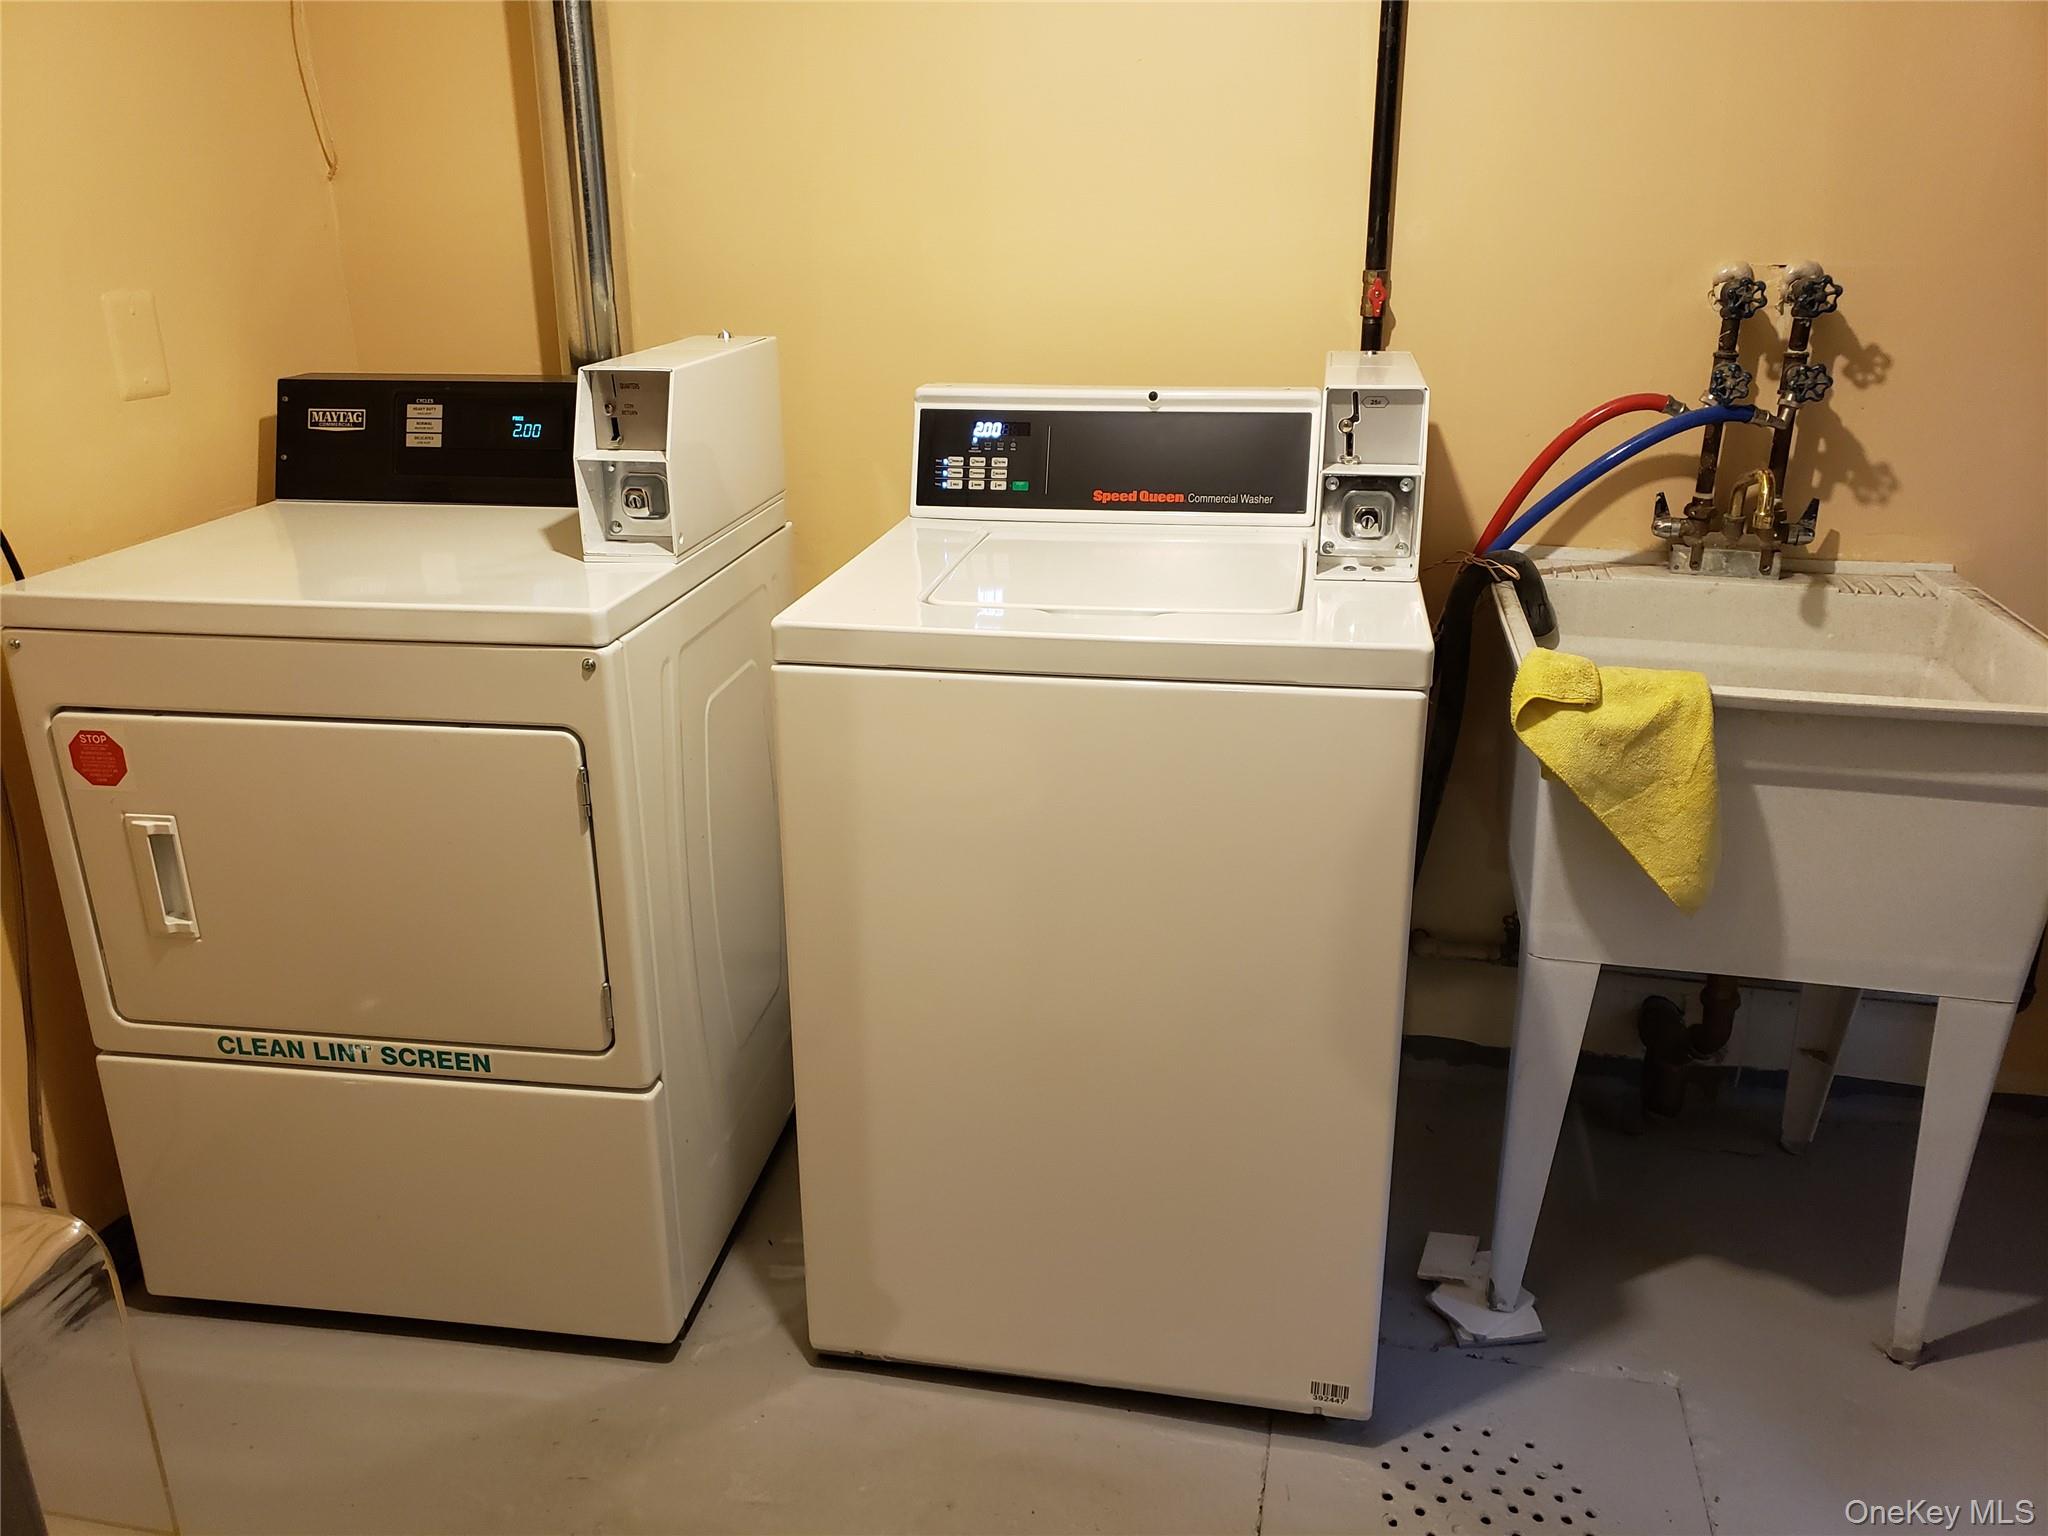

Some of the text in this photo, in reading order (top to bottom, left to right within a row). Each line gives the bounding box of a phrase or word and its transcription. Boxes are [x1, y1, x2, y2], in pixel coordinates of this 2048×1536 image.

[311, 411, 363, 423] MAYTAG
[512, 423, 542, 438] 2.00
[1092, 489, 1273, 505] Speed Queen Commercial Washer
[79, 734, 107, 744] STOP
[217, 1035, 492, 1073] CLEAN LINT SCREEN
